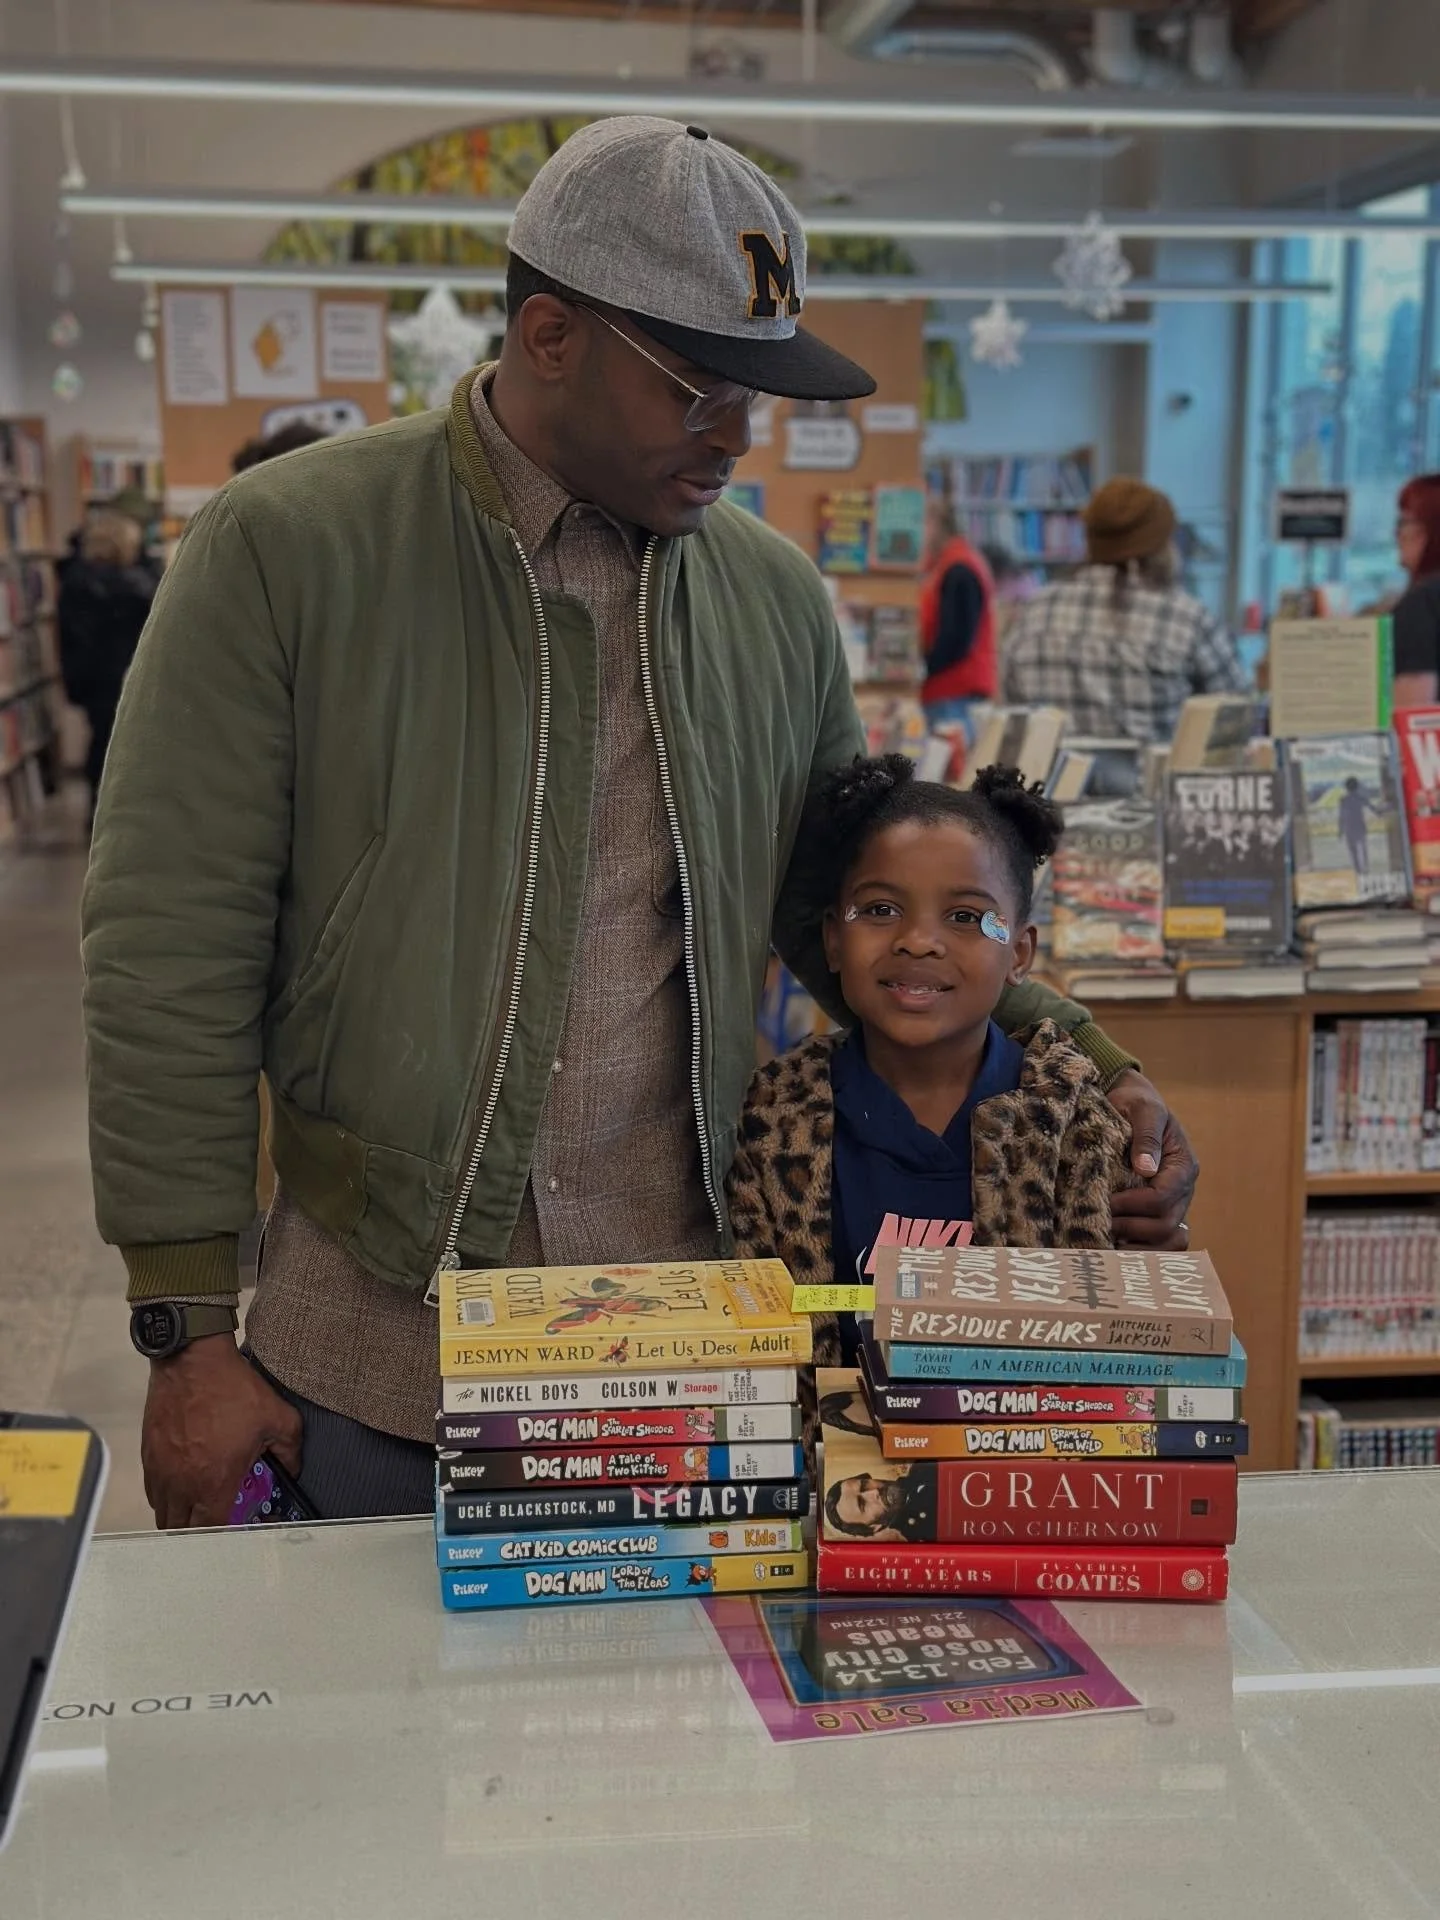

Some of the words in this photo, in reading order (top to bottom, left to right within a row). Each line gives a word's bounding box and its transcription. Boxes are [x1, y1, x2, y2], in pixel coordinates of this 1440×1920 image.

[737, 228, 801, 319] M
[657, 1269, 697, 1286] Us
[1007, 1247, 1067, 1304] YEARS
[1119, 1260, 1159, 1310] MITCHELL
[1157, 1252, 1213, 1316] JACKSON
[506, 1273, 543, 1319] WARD
[667, 1286, 708, 1312] Let
[890, 1305, 904, 1338] THE
[908, 1310, 1011, 1340] RESIDUE
[1018, 1318, 1102, 1345] YEARS
[1108, 1319, 1161, 1334] MITCHELL
[750, 1334, 791, 1353] Adult
[1105, 1330, 1171, 1348] JACKSON
[454, 1347, 528, 1365] JESMYN
[537, 1345, 595, 1363] WARD
[636, 1341, 665, 1359] Let
[672, 1340, 694, 1357] Us
[912, 1353, 954, 1365] TAYARI
[913, 1364, 951, 1376] JONES
[969, 1359, 991, 1373] AN
[996, 1359, 1083, 1376] AMERICAN
[1089, 1361, 1174, 1377] MARRIAGE
[480, 1385, 531, 1404] NICKEL
[541, 1383, 579, 1401] BOYS
[601, 1380, 657, 1399] COLSON
[683, 1382, 718, 1395] Storage
[958, 1389, 998, 1414] DOG
[1000, 1390, 1038, 1413] MAN
[517, 1416, 558, 1441] DOG
[560, 1416, 599, 1440] MAN
[966, 1428, 1004, 1454] DOG
[1006, 1428, 1046, 1453] MAN
[521, 1454, 562, 1480] DOG
[564, 1454, 603, 1479] MAN
[960, 1471, 1166, 1511] GRANT
[458, 1503, 492, 1520] UCHÉ
[500, 1499, 592, 1518] BLACKSTOCK,
[597, 1499, 616, 1513] MD
[632, 1485, 759, 1520] LEGACY
[744, 1528, 777, 1546] Kids
[963, 1520, 1016, 1537] RON
[1026, 1520, 1164, 1538] CHERNOW
[500, 1541, 532, 1560] CAT
[844, 1567, 912, 1581] EIGHT
[924, 1568, 993, 1583] YEARS
[1042, 1561, 1137, 1573] TA-NEHISI
[524, 1571, 565, 1597] DOG
[568, 1570, 607, 1594] MAN
[1036, 1573, 1141, 1593] COATES
[831, 1616, 889, 1630] 122nd
[898, 1614, 921, 1623] NE
[929, 1610, 967, 1620] 221
[847, 1623, 976, 1647] Reads
[921, 1637, 1028, 1657] Rose
[823, 1647, 909, 1668] City
[131, 1696, 192, 1714] DO
[207, 1690, 273, 1709] WE
[946, 1688, 1098, 1719] Media
[42, 1701, 115, 1720] NO
[813, 1704, 930, 1732] Sale
